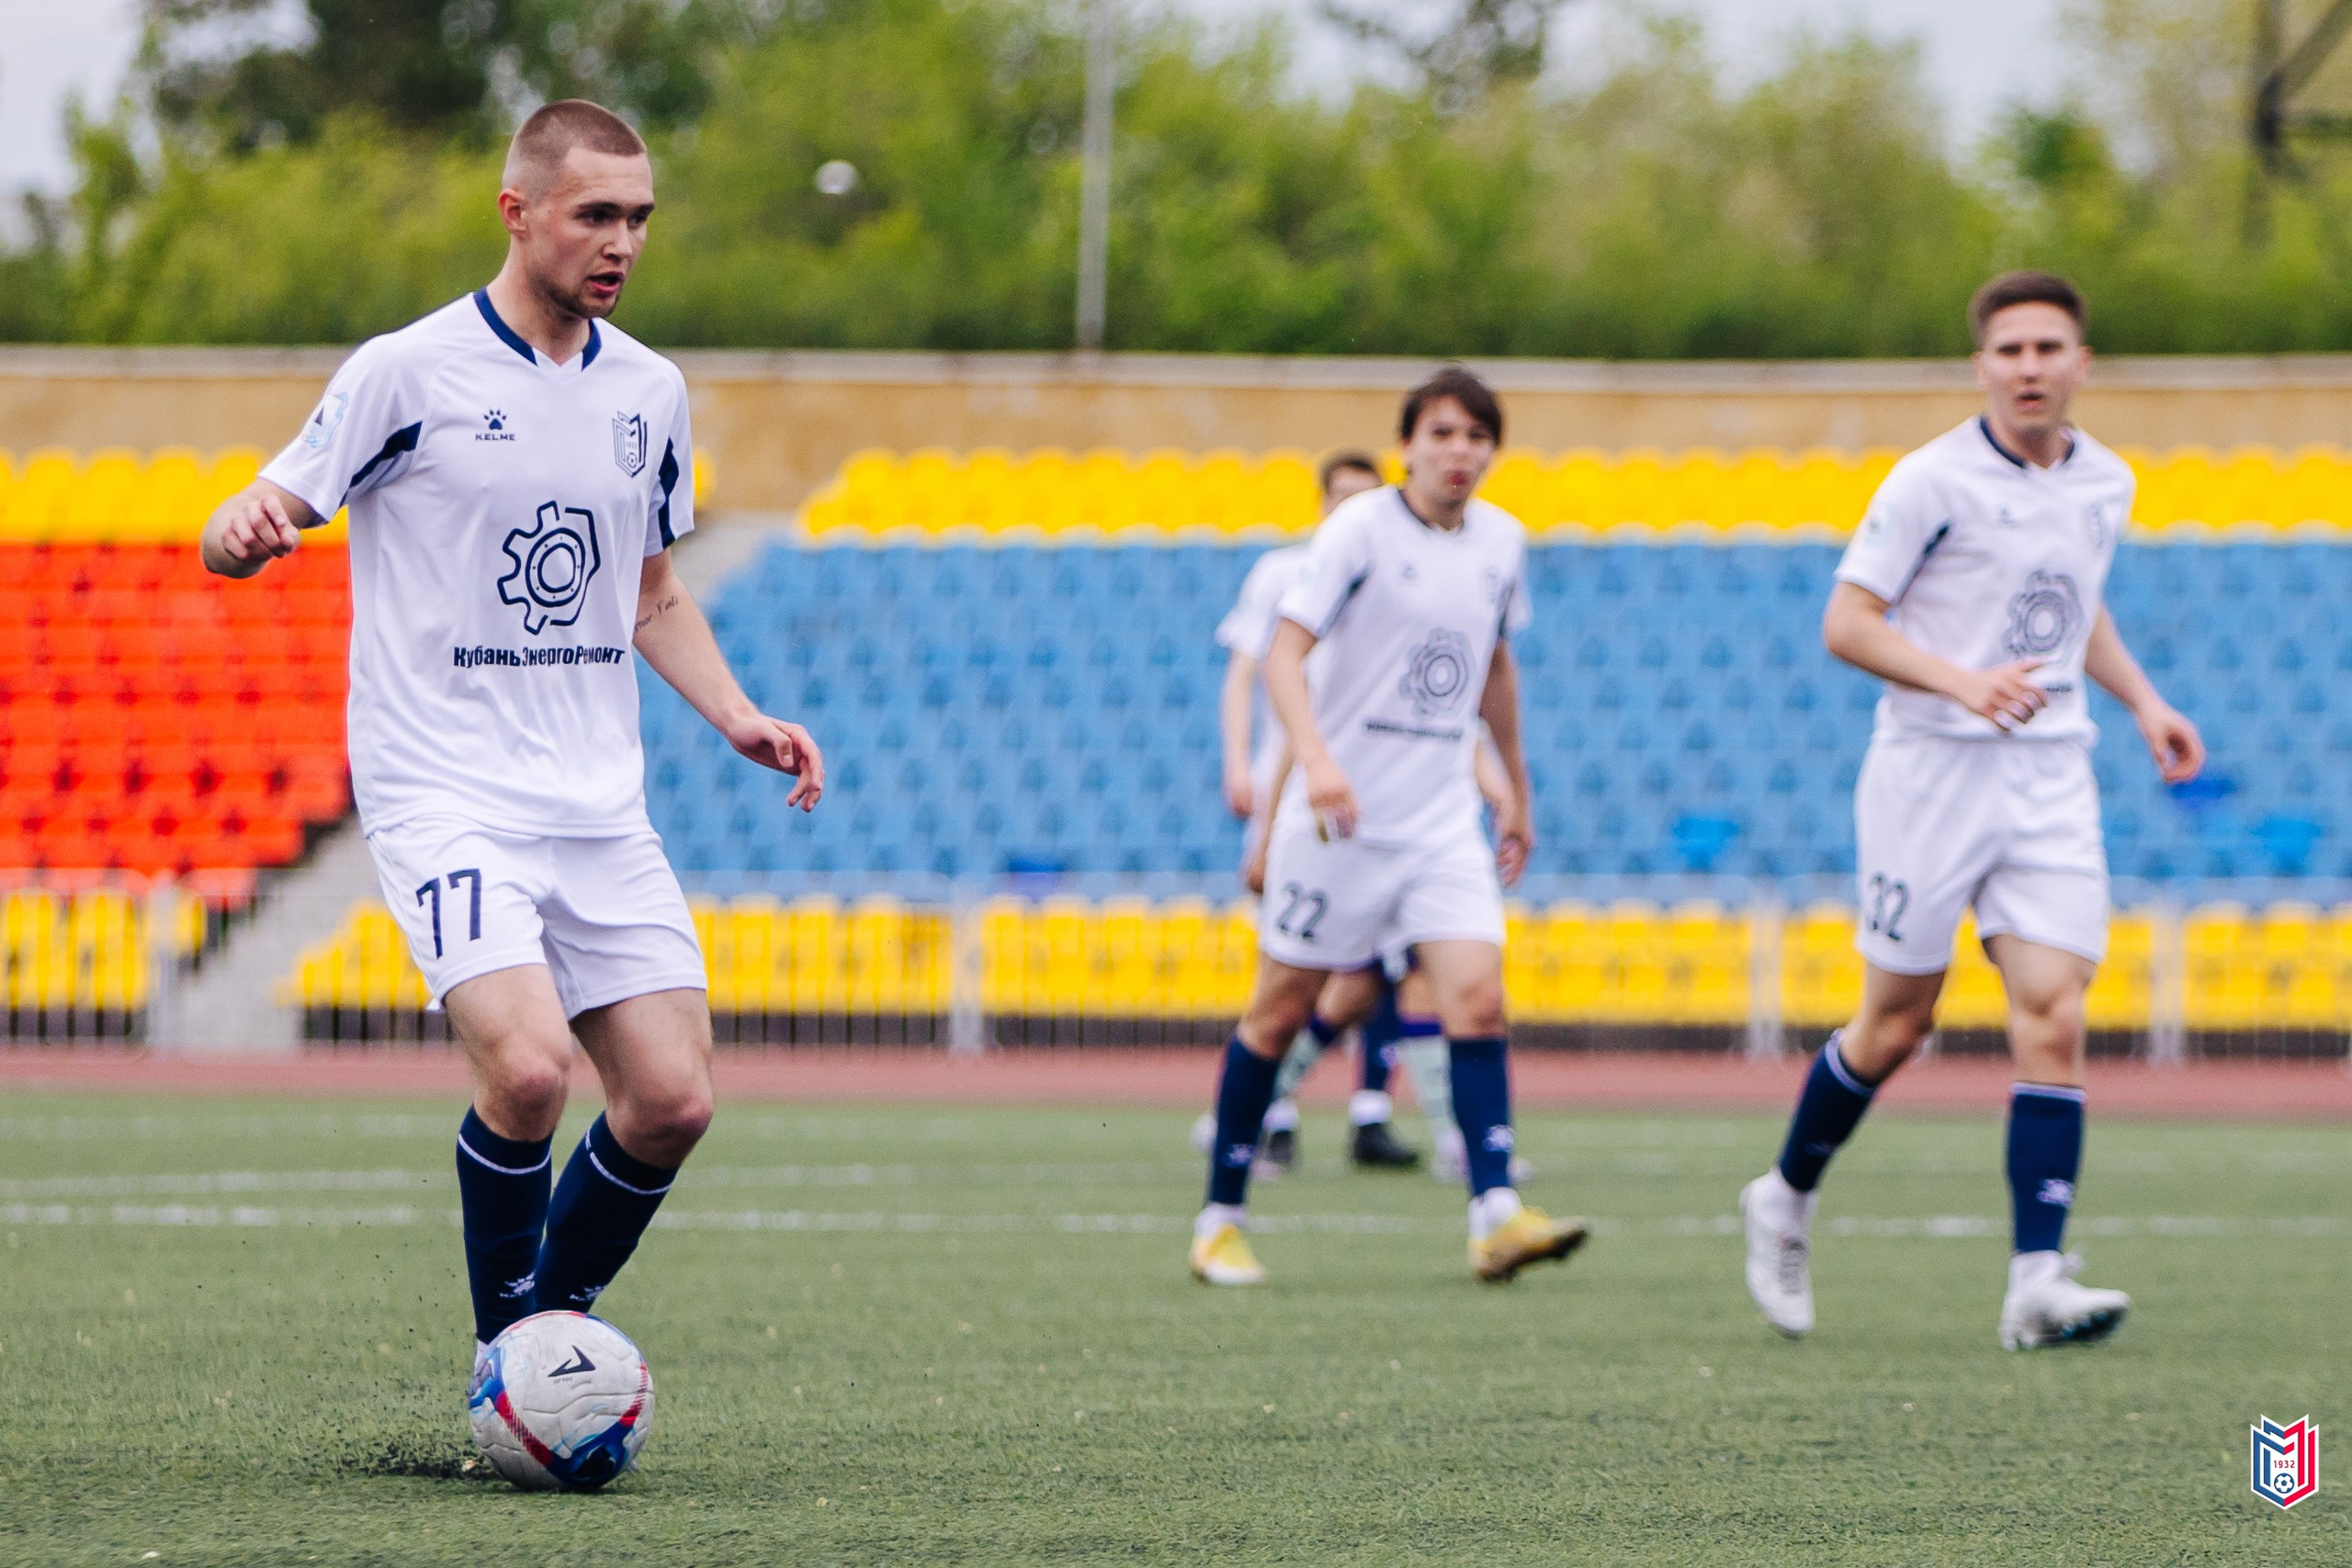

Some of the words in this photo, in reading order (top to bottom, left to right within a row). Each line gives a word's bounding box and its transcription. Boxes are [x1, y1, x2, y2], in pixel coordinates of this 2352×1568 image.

[475, 433, 516, 441] KELME
[415, 867, 482, 961] 77
[1276, 880, 1329, 943] 22
[1866, 871, 1909, 942] 32
